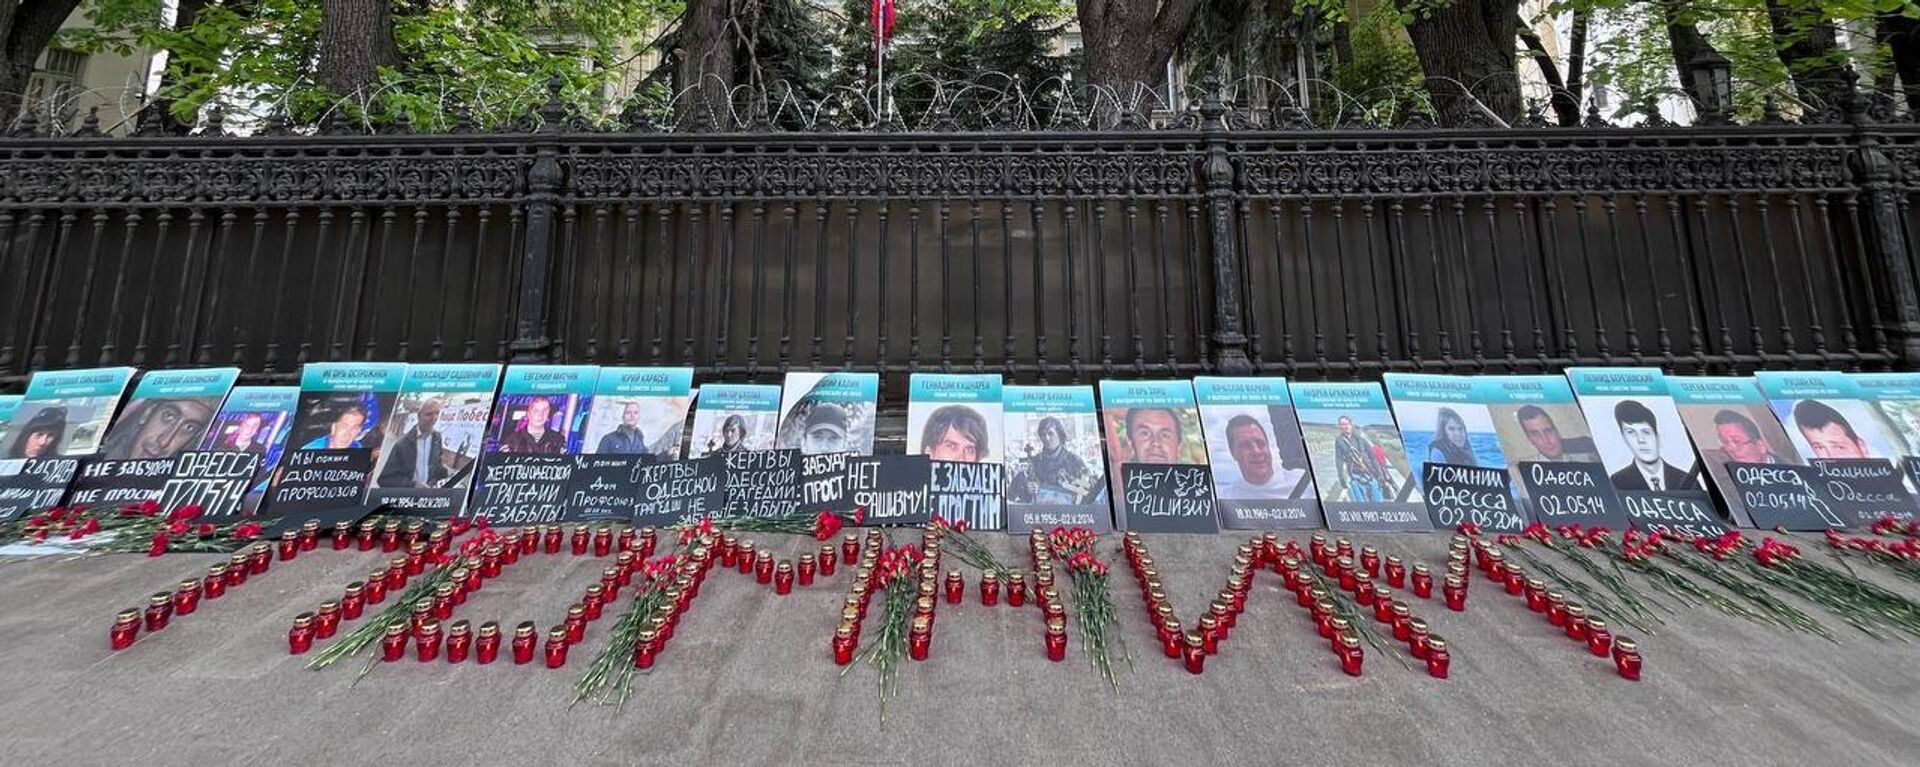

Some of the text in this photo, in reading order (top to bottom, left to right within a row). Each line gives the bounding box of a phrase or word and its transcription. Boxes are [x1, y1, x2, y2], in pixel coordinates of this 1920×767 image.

[84, 461, 116, 477] НЕ
[175, 452, 260, 478] ОДЕССА
[641, 461, 699, 485] ЖЕРТВЫ
[847, 461, 881, 490] НЕТ
[941, 463, 1001, 495] ЗАБУДЕМ
[74, 489, 102, 504] НЕ
[484, 482, 561, 505] ТРАГЕДИИ
[687, 497, 706, 514] НЕ
[1625, 496, 1712, 522] ОДЕССА
